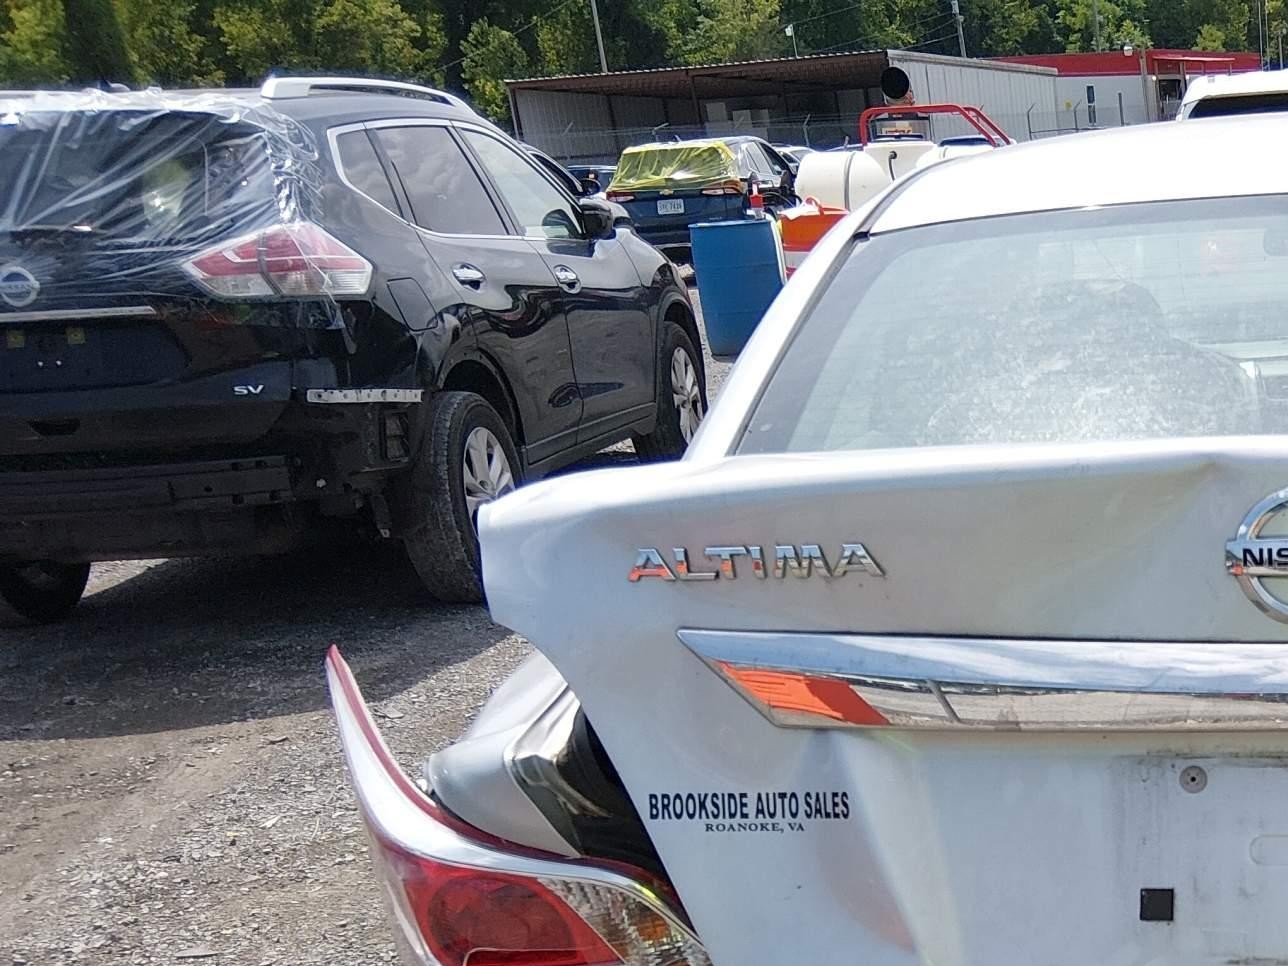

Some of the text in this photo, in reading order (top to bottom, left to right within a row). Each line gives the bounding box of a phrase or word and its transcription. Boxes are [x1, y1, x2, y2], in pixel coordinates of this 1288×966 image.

[233, 384, 264, 395] SV
[628, 543, 886, 582] ALTIMA
[649, 792, 850, 819] BROOKSIDE AUTO SALES
[704, 822, 805, 833] ROANOKE, VA
